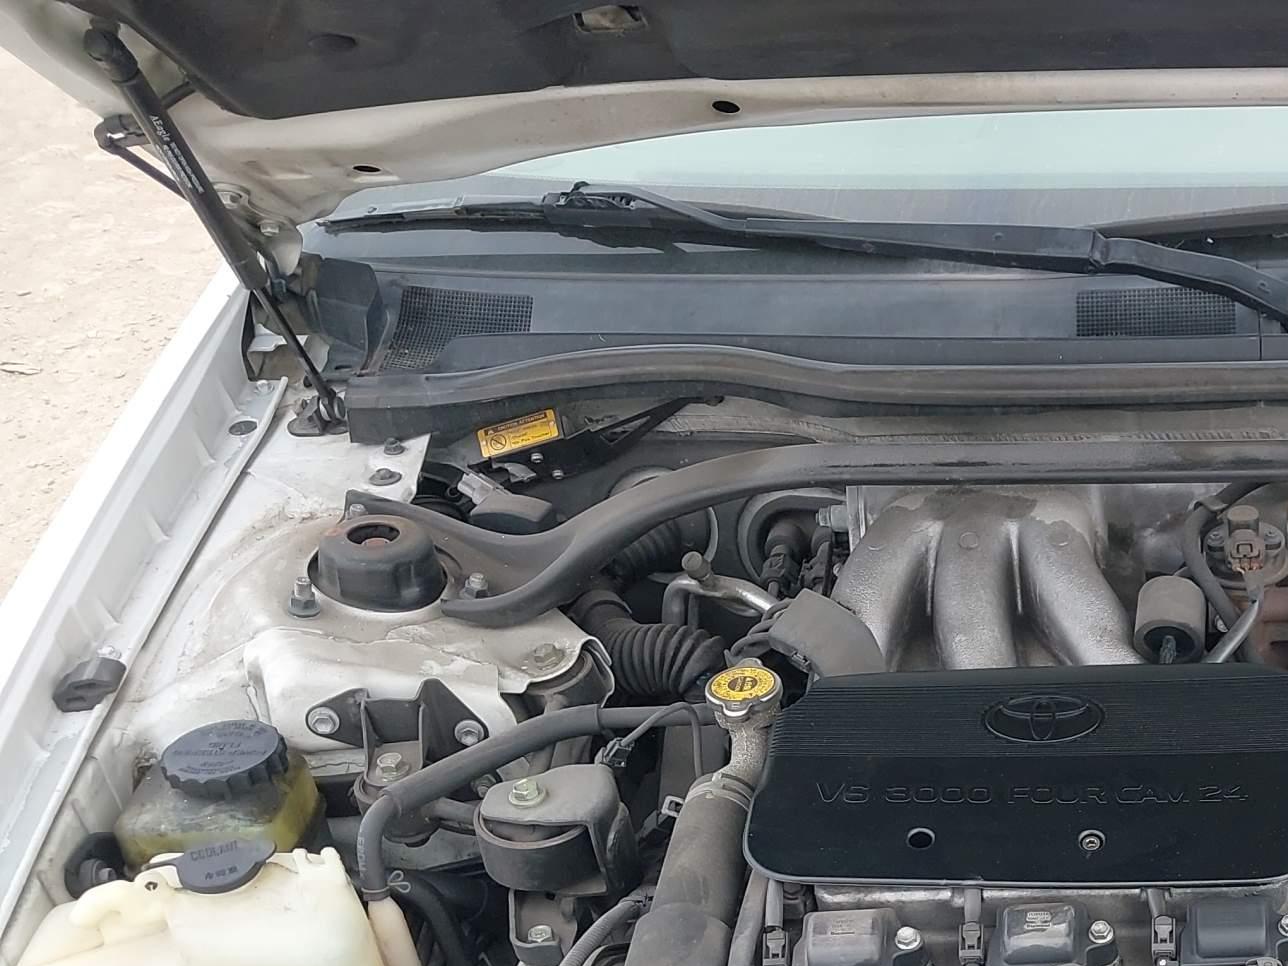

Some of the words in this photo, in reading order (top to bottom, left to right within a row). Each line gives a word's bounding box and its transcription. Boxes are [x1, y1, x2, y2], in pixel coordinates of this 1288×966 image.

[816, 783, 869, 804] V6
[884, 787, 992, 804] 3000
[1007, 787, 1108, 804] FOUR
[1116, 784, 1191, 803] CAM
[1199, 785, 1249, 802] 24
